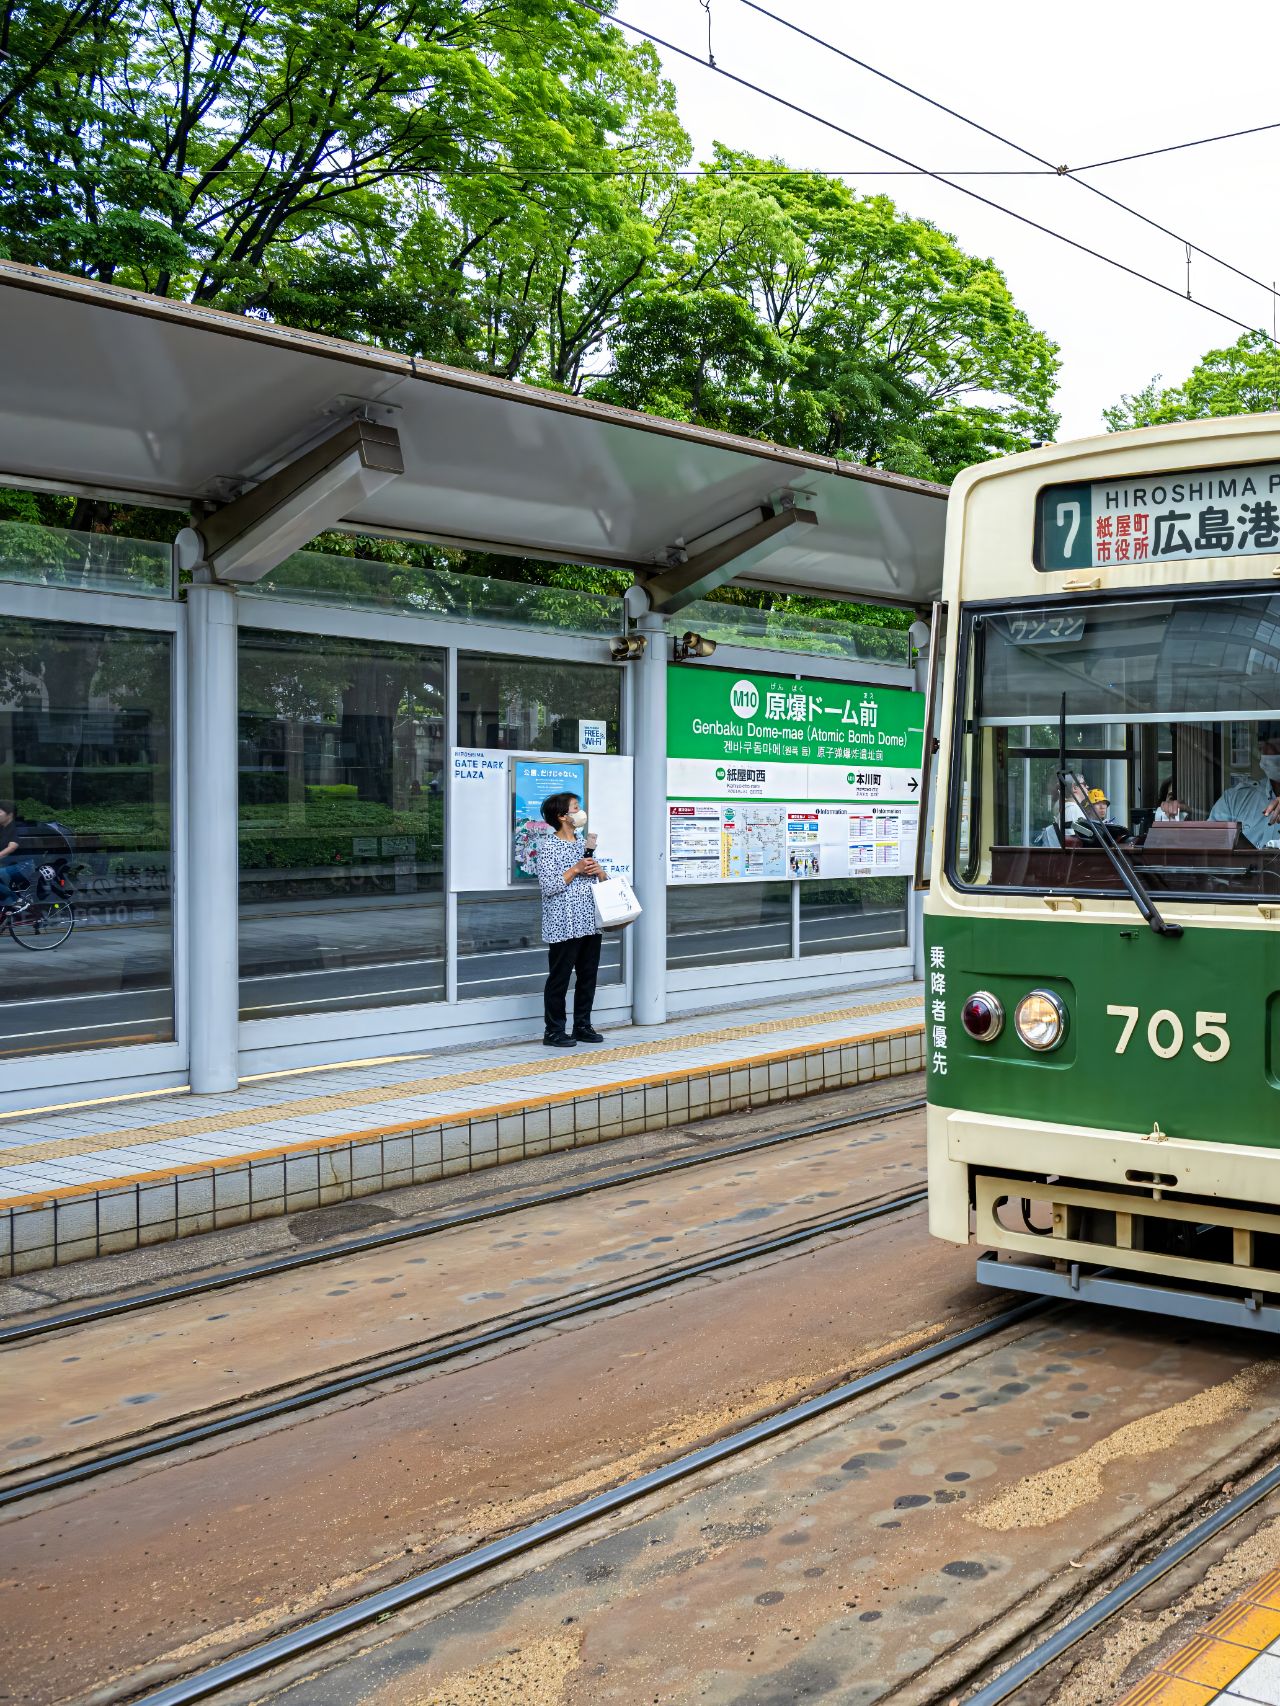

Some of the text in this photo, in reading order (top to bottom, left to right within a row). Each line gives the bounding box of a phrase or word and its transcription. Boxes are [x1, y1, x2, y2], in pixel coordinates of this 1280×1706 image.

[1105, 476, 1257, 509] HIROSHIMA
[1056, 501, 1081, 559] 7
[1096, 512, 1150, 539] 紙屋町
[1096, 536, 1150, 563] 市役所
[1010, 617, 1083, 640] ワンマン
[733, 690, 757, 708] M10
[765, 691, 879, 728] 原爆ドーム前
[584, 729, 600, 737] FREE
[692, 718, 908, 748] Genbaku Dome-mae (Atomic Bomb Dome)
[455, 759, 504, 769] GATE PARK
[455, 770, 484, 779] PLAZA
[726, 768, 766, 782] 紙屋町西
[855, 773, 882, 786] 本川町
[610, 865, 630, 873] PARK
[930, 946, 948, 1075] 乗降者優先
[1106, 1004, 1231, 1062] 705
